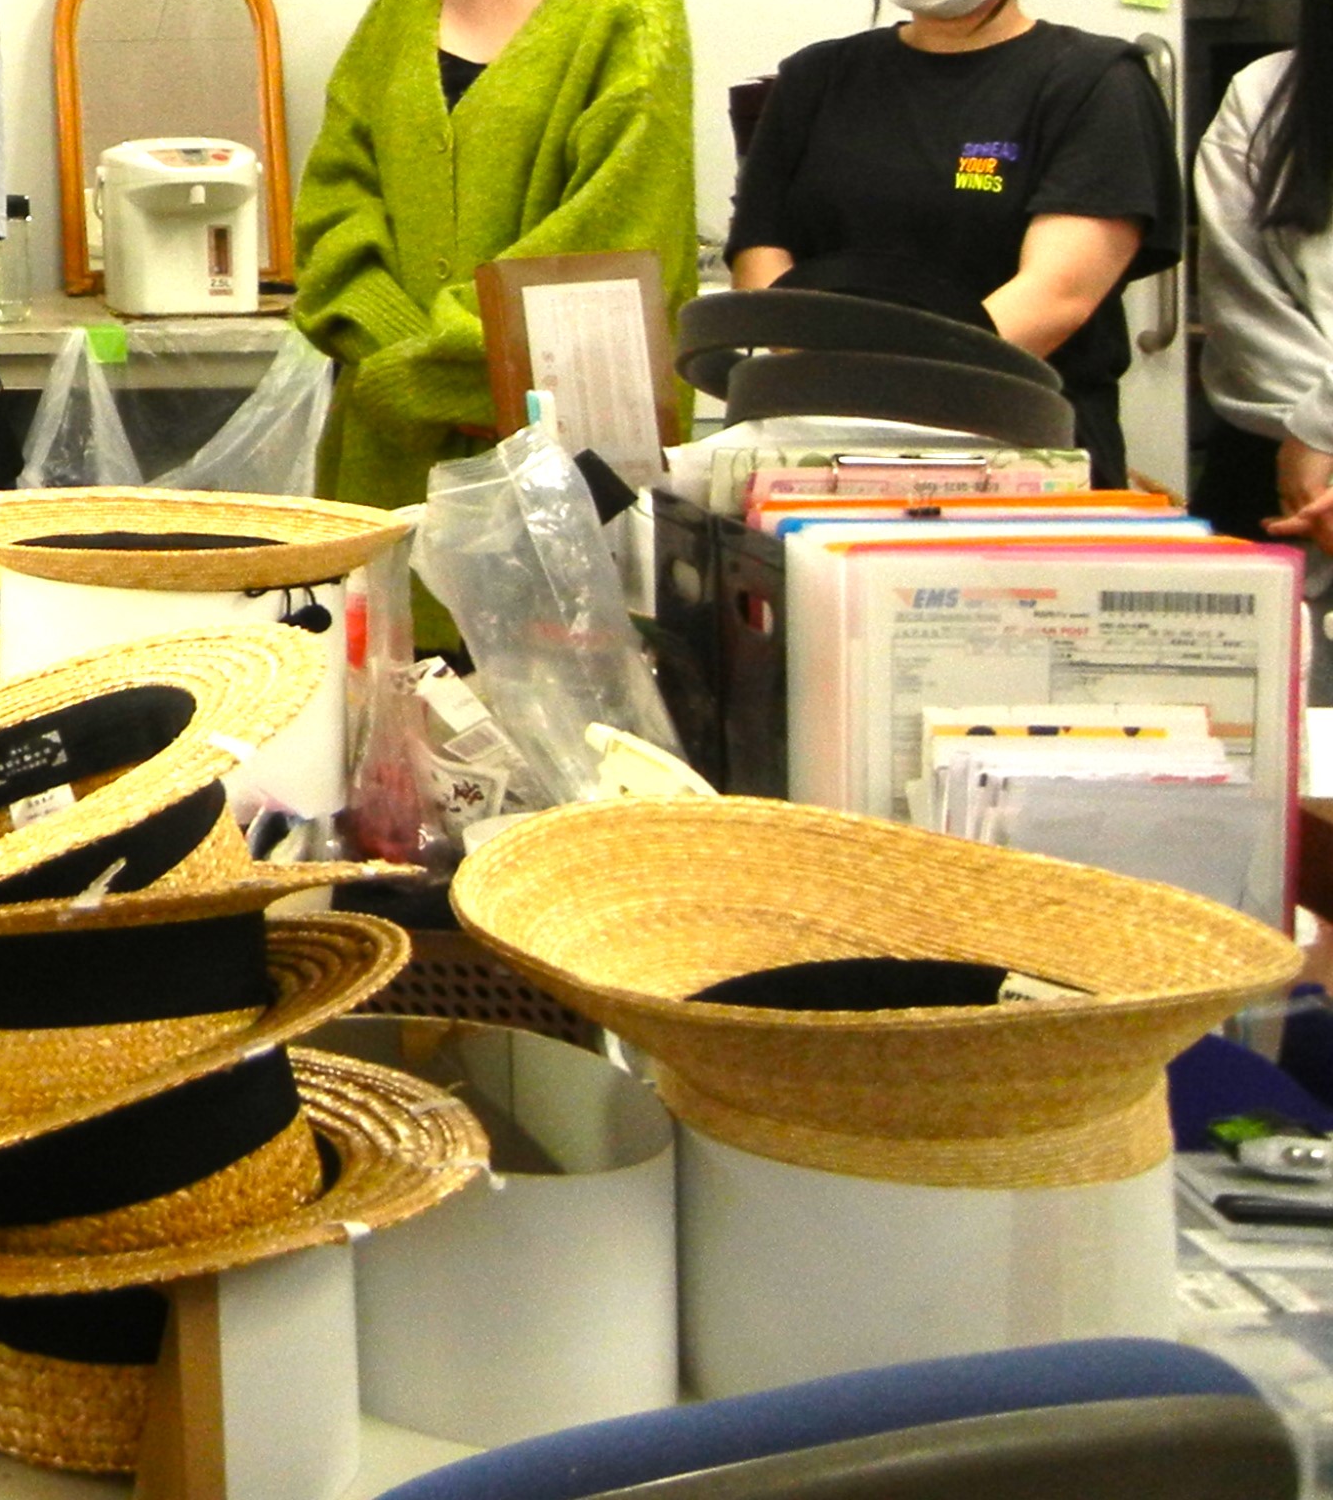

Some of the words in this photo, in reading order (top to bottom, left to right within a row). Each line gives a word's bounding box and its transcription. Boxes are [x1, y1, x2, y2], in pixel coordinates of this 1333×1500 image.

[961, 141, 1019, 162] SPREAD
[958, 155, 999, 175] YOUR
[954, 171, 1004, 194] WINGS
[912, 588, 961, 609] EMS
